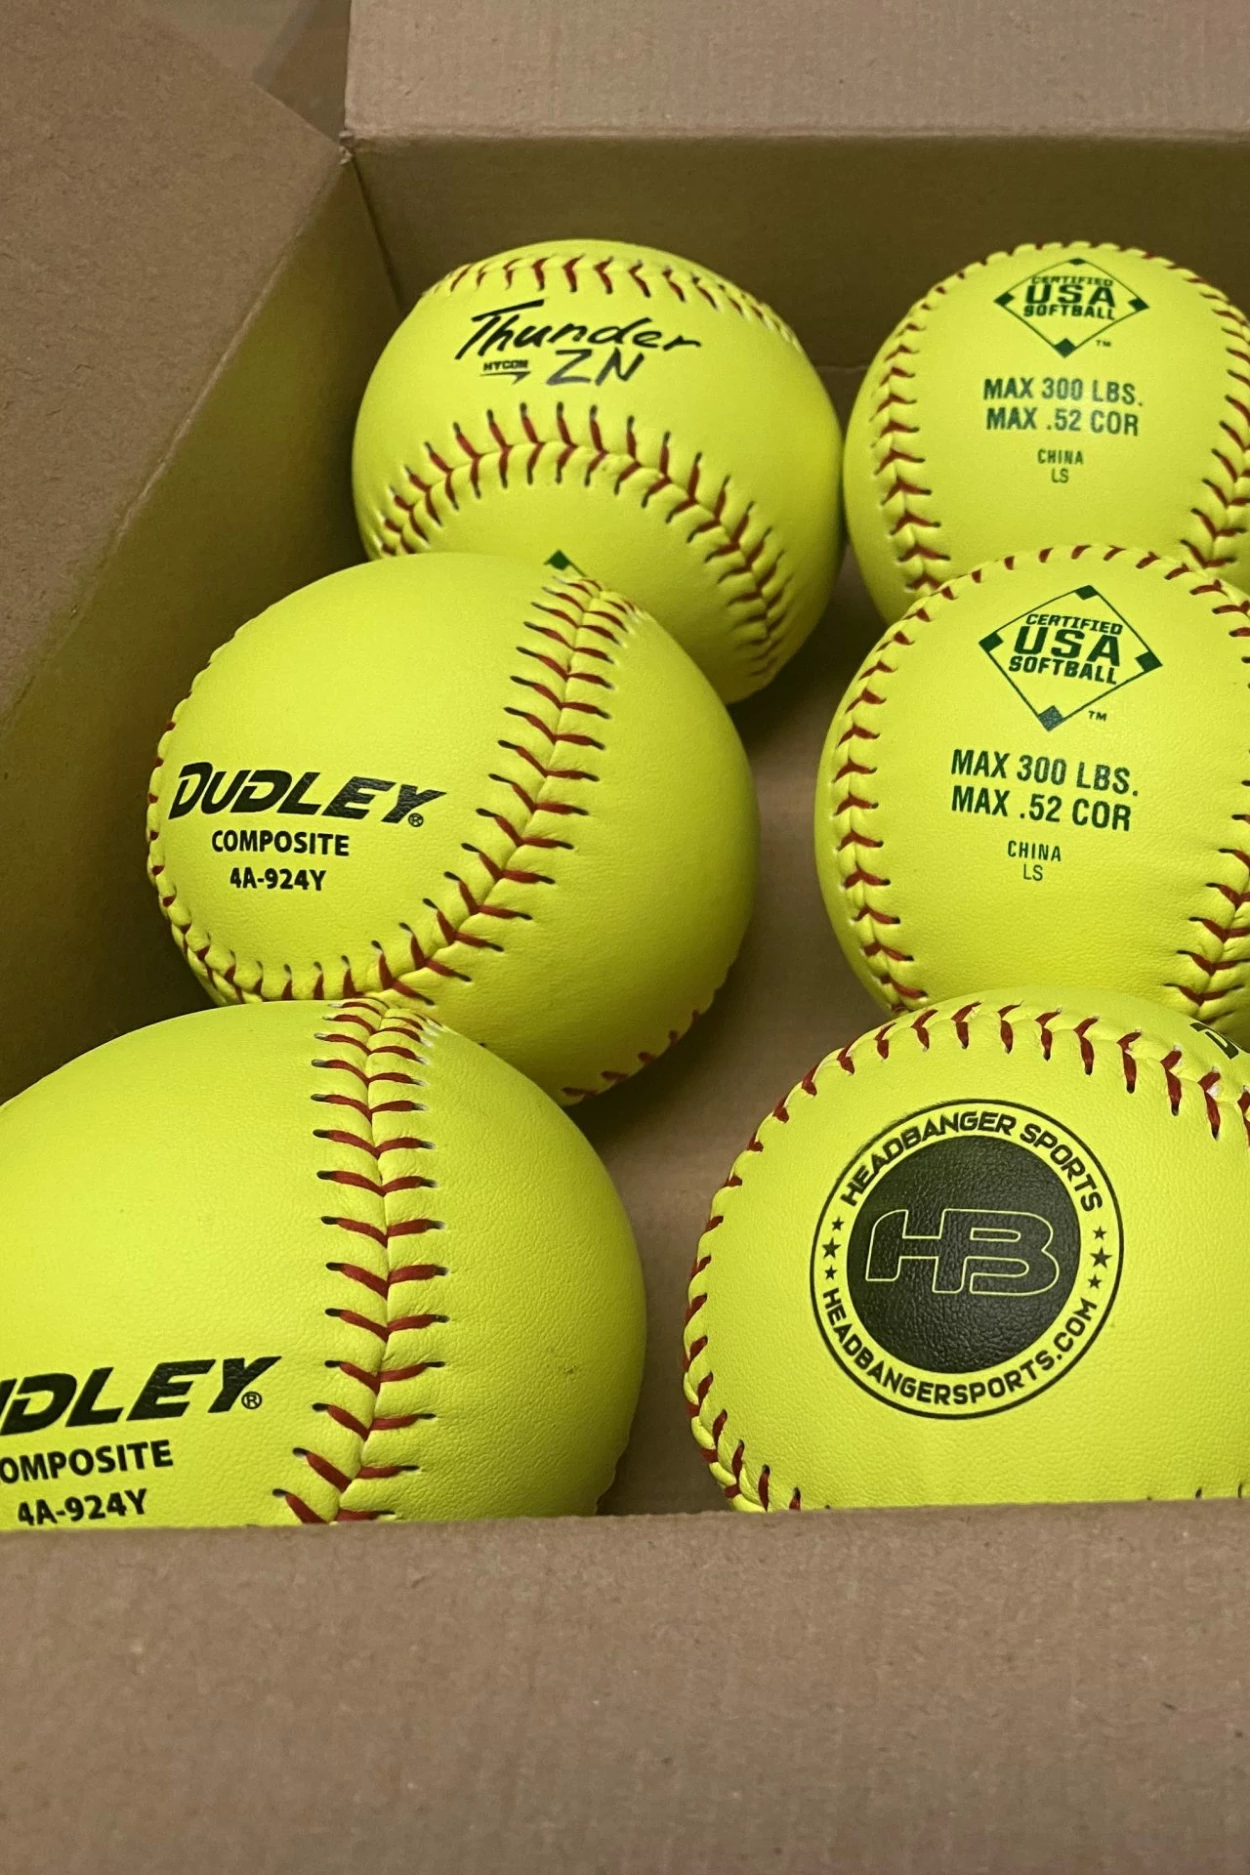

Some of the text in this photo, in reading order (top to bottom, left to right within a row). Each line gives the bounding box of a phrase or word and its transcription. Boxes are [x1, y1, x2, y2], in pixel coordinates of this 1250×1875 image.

[1024, 284, 1116, 308] USA
[1031, 276, 1113, 287] CERTIFIED
[1023, 304, 1115, 320] SOFTBALL
[455, 299, 701, 360] Thunder
[546, 347, 645, 386] ZN
[983, 376, 1143, 407] MAX 300 LBS.
[986, 407, 1139, 437] MAX .52 COR
[1037, 449, 1084, 465] CHINA
[1051, 468, 1069, 483] LS
[1026, 613, 1123, 635] CERTIFIED
[1013, 626, 1120, 667] USA
[1008, 656, 1117, 685] SOFTBALL
[951, 748, 1139, 797] MAX 300 LBS.
[951, 784, 1131, 832] MAX .52 COR
[211, 830, 350, 856] COMPOSITE
[1007, 840, 1062, 862] CHINA
[229, 866, 326, 891] 4A-924Y
[1023, 863, 1043, 882] LS
[840, 1111, 1103, 1212] HEADBANGER SPORTS
[865, 1208, 1060, 1296] HB
[822, 1287, 1097, 1405] HEADBANGERSPORTS.COM
[18, 1488, 147, 1526] 4A-924Y
